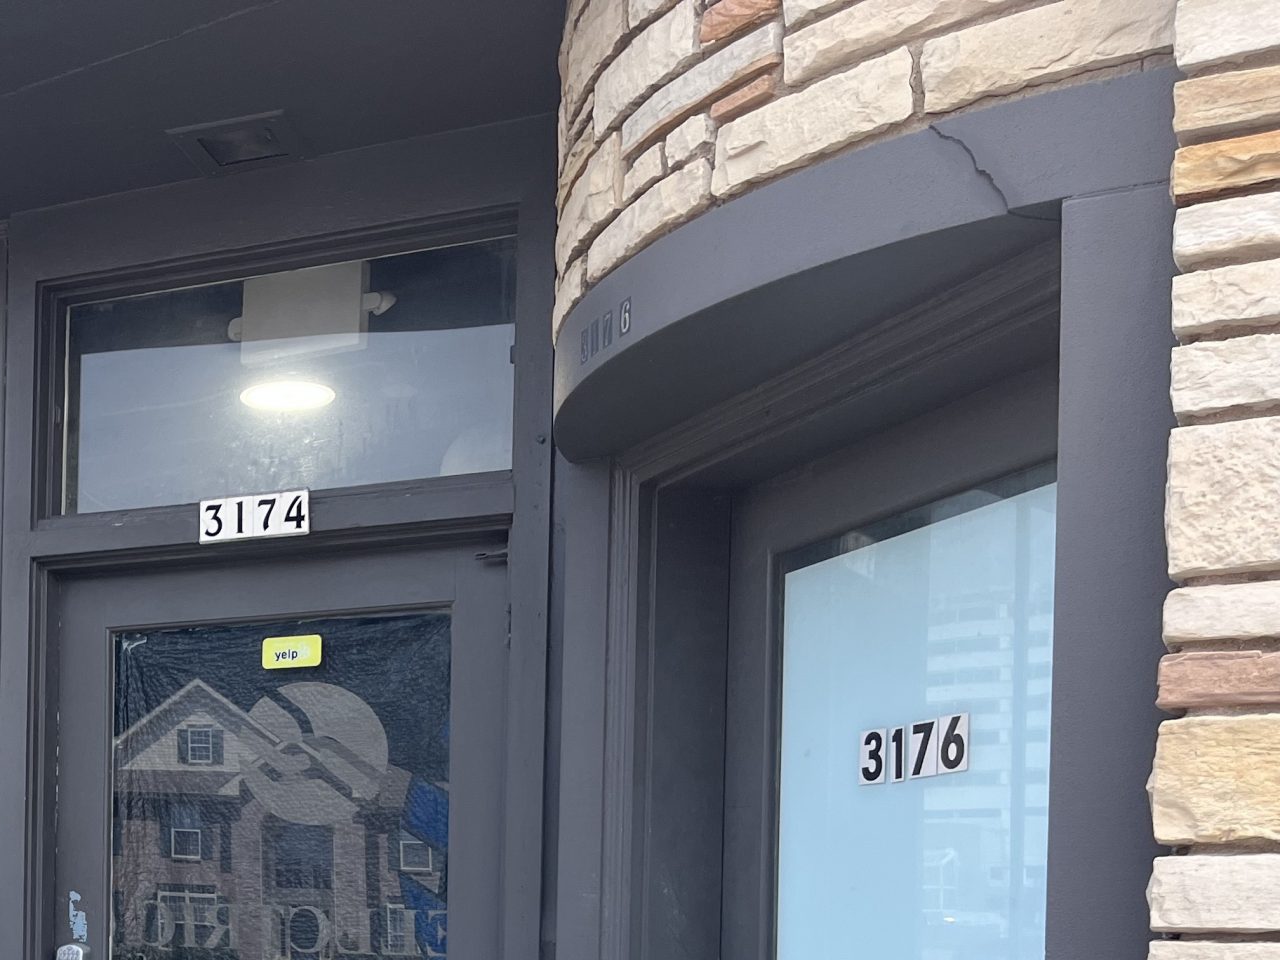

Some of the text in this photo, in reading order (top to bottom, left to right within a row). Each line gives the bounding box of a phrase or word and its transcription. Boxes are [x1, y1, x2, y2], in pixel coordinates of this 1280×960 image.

[204, 495, 306, 536] 3174
[274, 649, 298, 661] yelp
[861, 715, 965, 782] 3176
